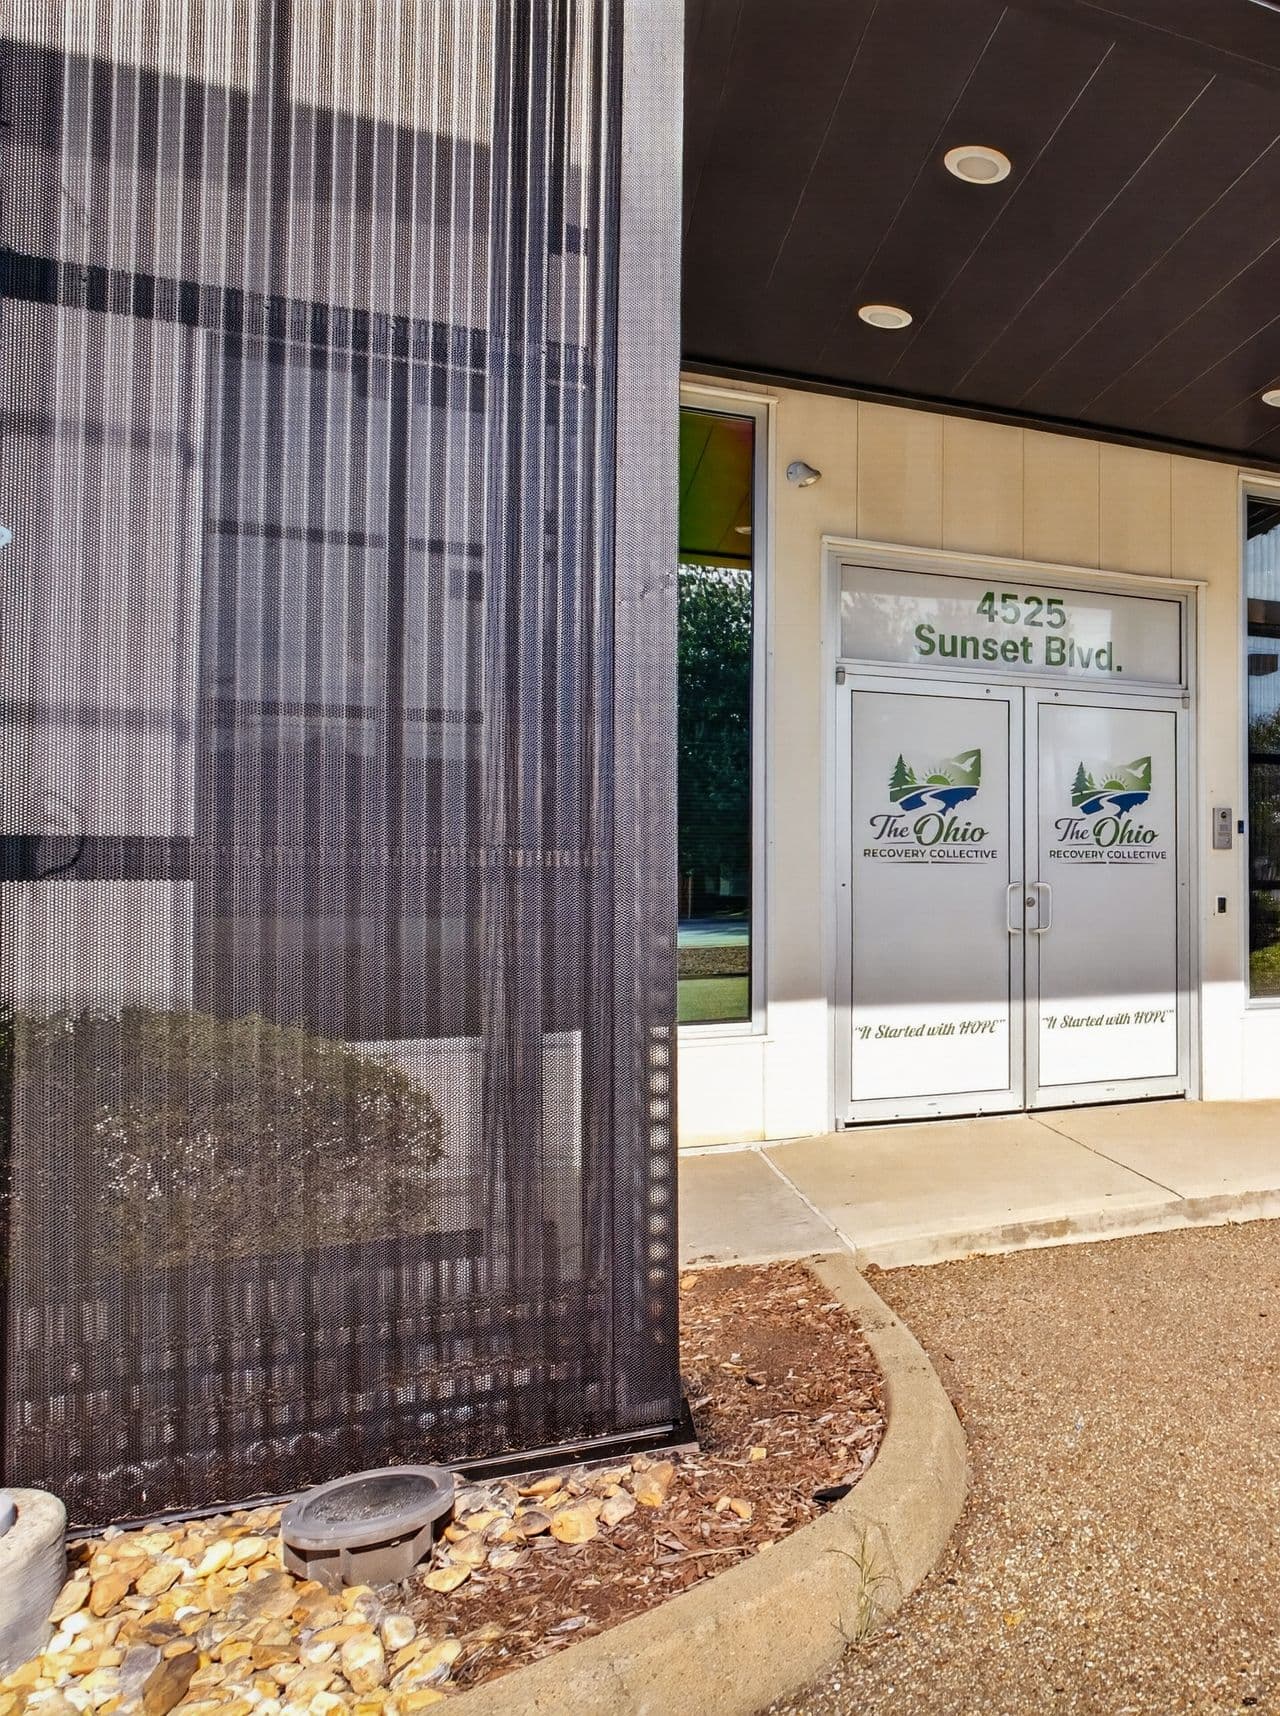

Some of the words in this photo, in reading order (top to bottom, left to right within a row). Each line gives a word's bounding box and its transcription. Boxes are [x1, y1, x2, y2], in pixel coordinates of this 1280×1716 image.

[975, 591, 1068, 630] 4525
[914, 623, 1034, 664] Sunset
[1045, 635, 1123, 673] Blvd.
[869, 814, 909, 841] The
[913, 812, 989, 847] Ohio
[1054, 817, 1090, 842] The
[1092, 816, 1160, 848] Ohio
[863, 848, 927, 859] RECOVERY
[929, 848, 998, 860] COLLECTIVE
[1049, 850, 1105, 860] RECOVERY
[1107, 850, 1168, 860] COLLECTIVE
[874, 1024, 926, 1039] Started
[926, 1022, 956, 1036] with
[1060, 1014, 1104, 1029] Started
[1105, 1012, 1131, 1026] with
